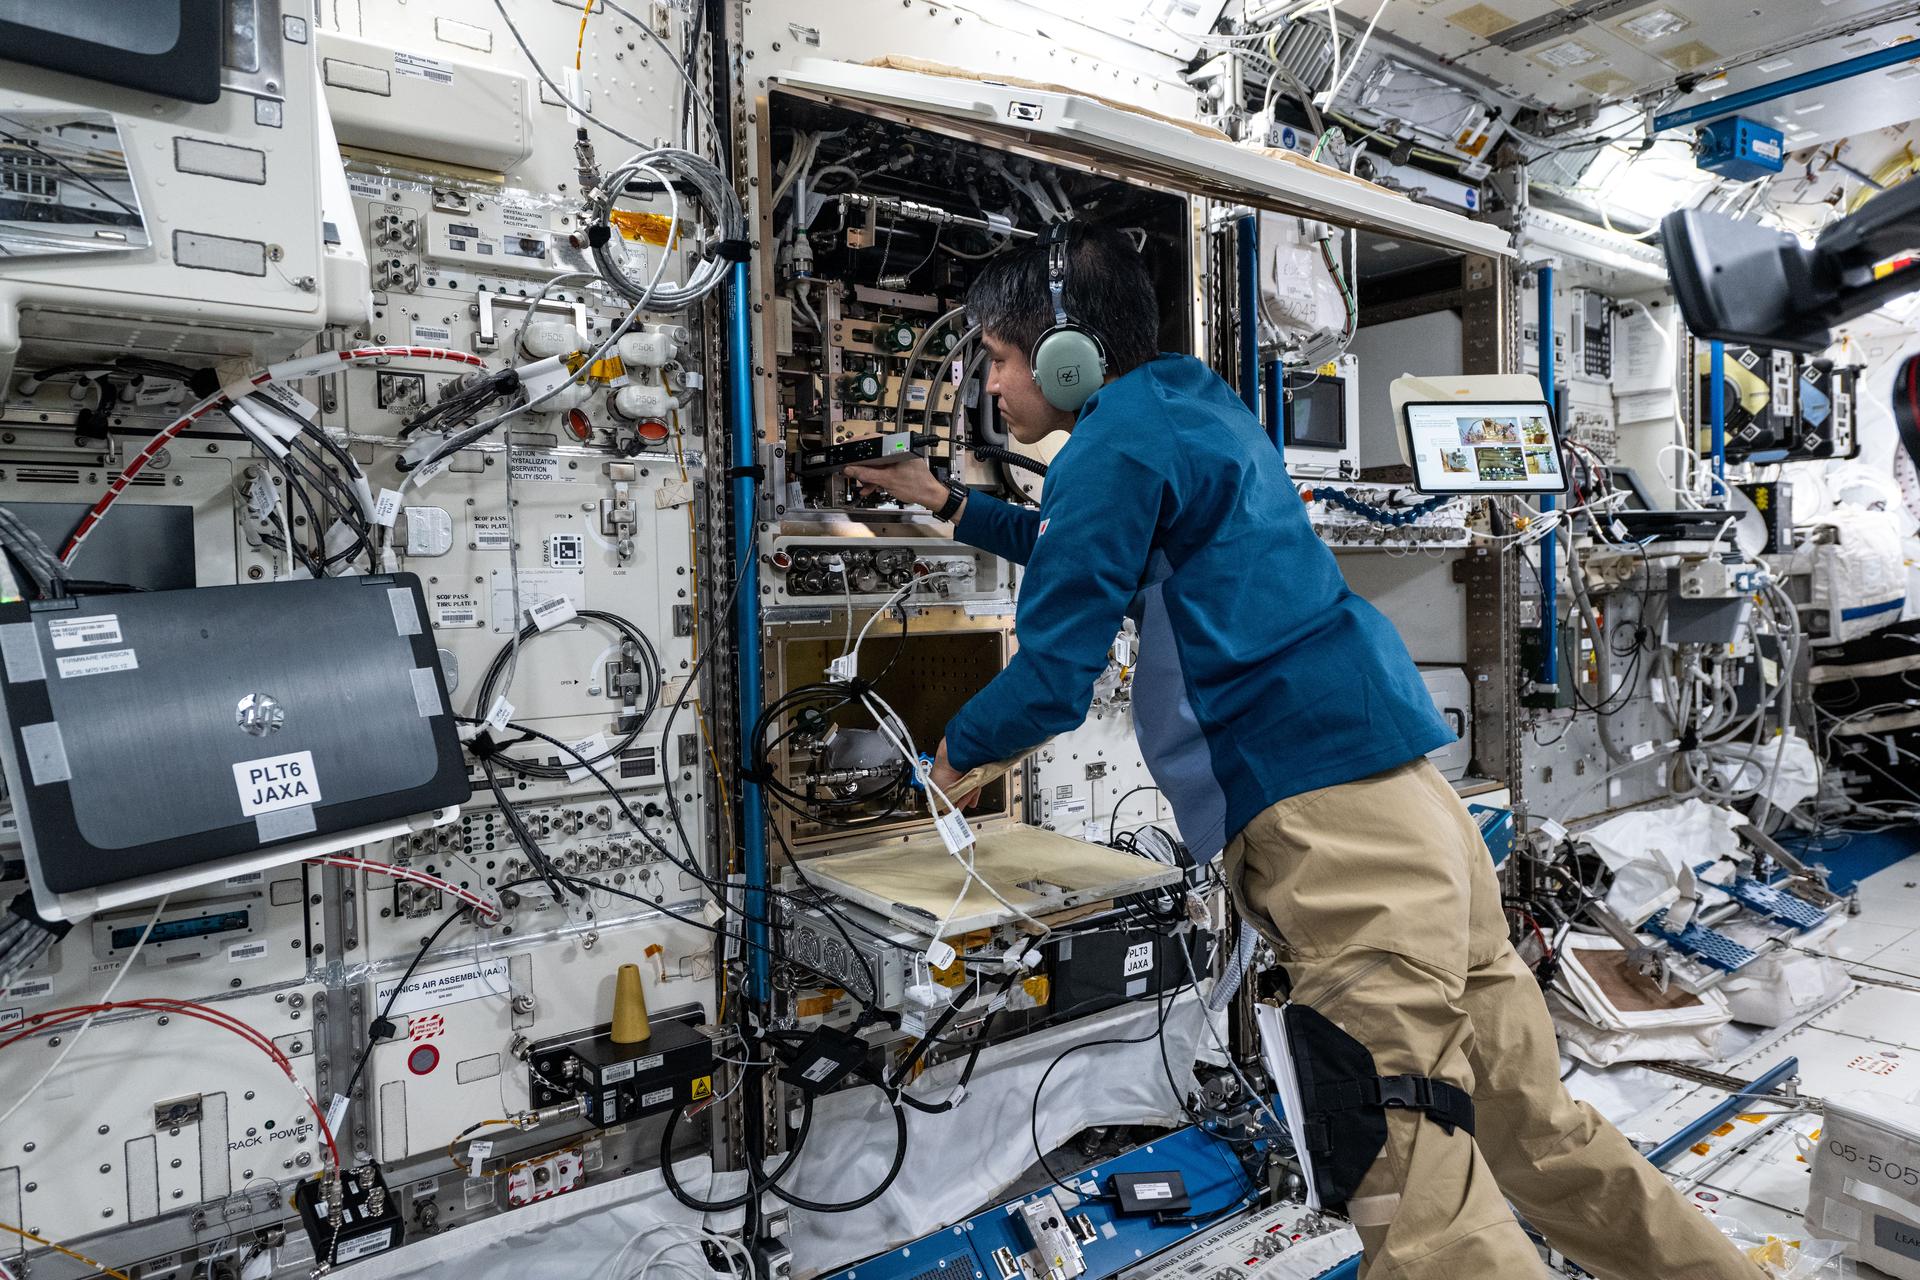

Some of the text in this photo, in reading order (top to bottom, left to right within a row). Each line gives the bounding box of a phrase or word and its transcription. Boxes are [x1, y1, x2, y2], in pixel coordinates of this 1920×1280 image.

[1272, 130, 1279, 144] 8
[503, 208, 543, 220] CRYSTALLIZATION
[503, 214, 528, 222] RESEARCH
[503, 220, 523, 228] FACILITY
[495, 272, 528, 282] TEMPERATURE
[541, 332, 564, 342] P505
[632, 343, 654, 352] P506
[635, 396, 657, 405] P508
[512, 457, 557, 465] RYSTALLIZATION
[512, 465, 547, 473] BSERVATION
[62, 651, 130, 664] FIRMWARE VERSION
[249, 762, 302, 785] PLT6
[252, 781, 309, 805] JAXA
[1129, 946, 1148, 959] PLT3
[1127, 959, 1149, 972] JAXA
[421, 980, 437, 990] AIR
[438, 970, 482, 988] ASSEMBLY
[1, 1013, 19, 1022] (IPU)
[605, 1114, 615, 1122] OFF
[228, 1123, 314, 1152] RACK POWER
[1153, 1256, 1180, 1274] MINUS
[1177, 1243, 1205, 1260] EIGHTY
[1204, 1236, 1220, 1248] LAB
[1218, 1221, 1249, 1240] FREEZER
[1249, 1215, 1262, 1224] ISS
[1177, 1254, 1206, 1271] ELECTRONIC
[1205, 1247, 1217, 1257] UNIT
